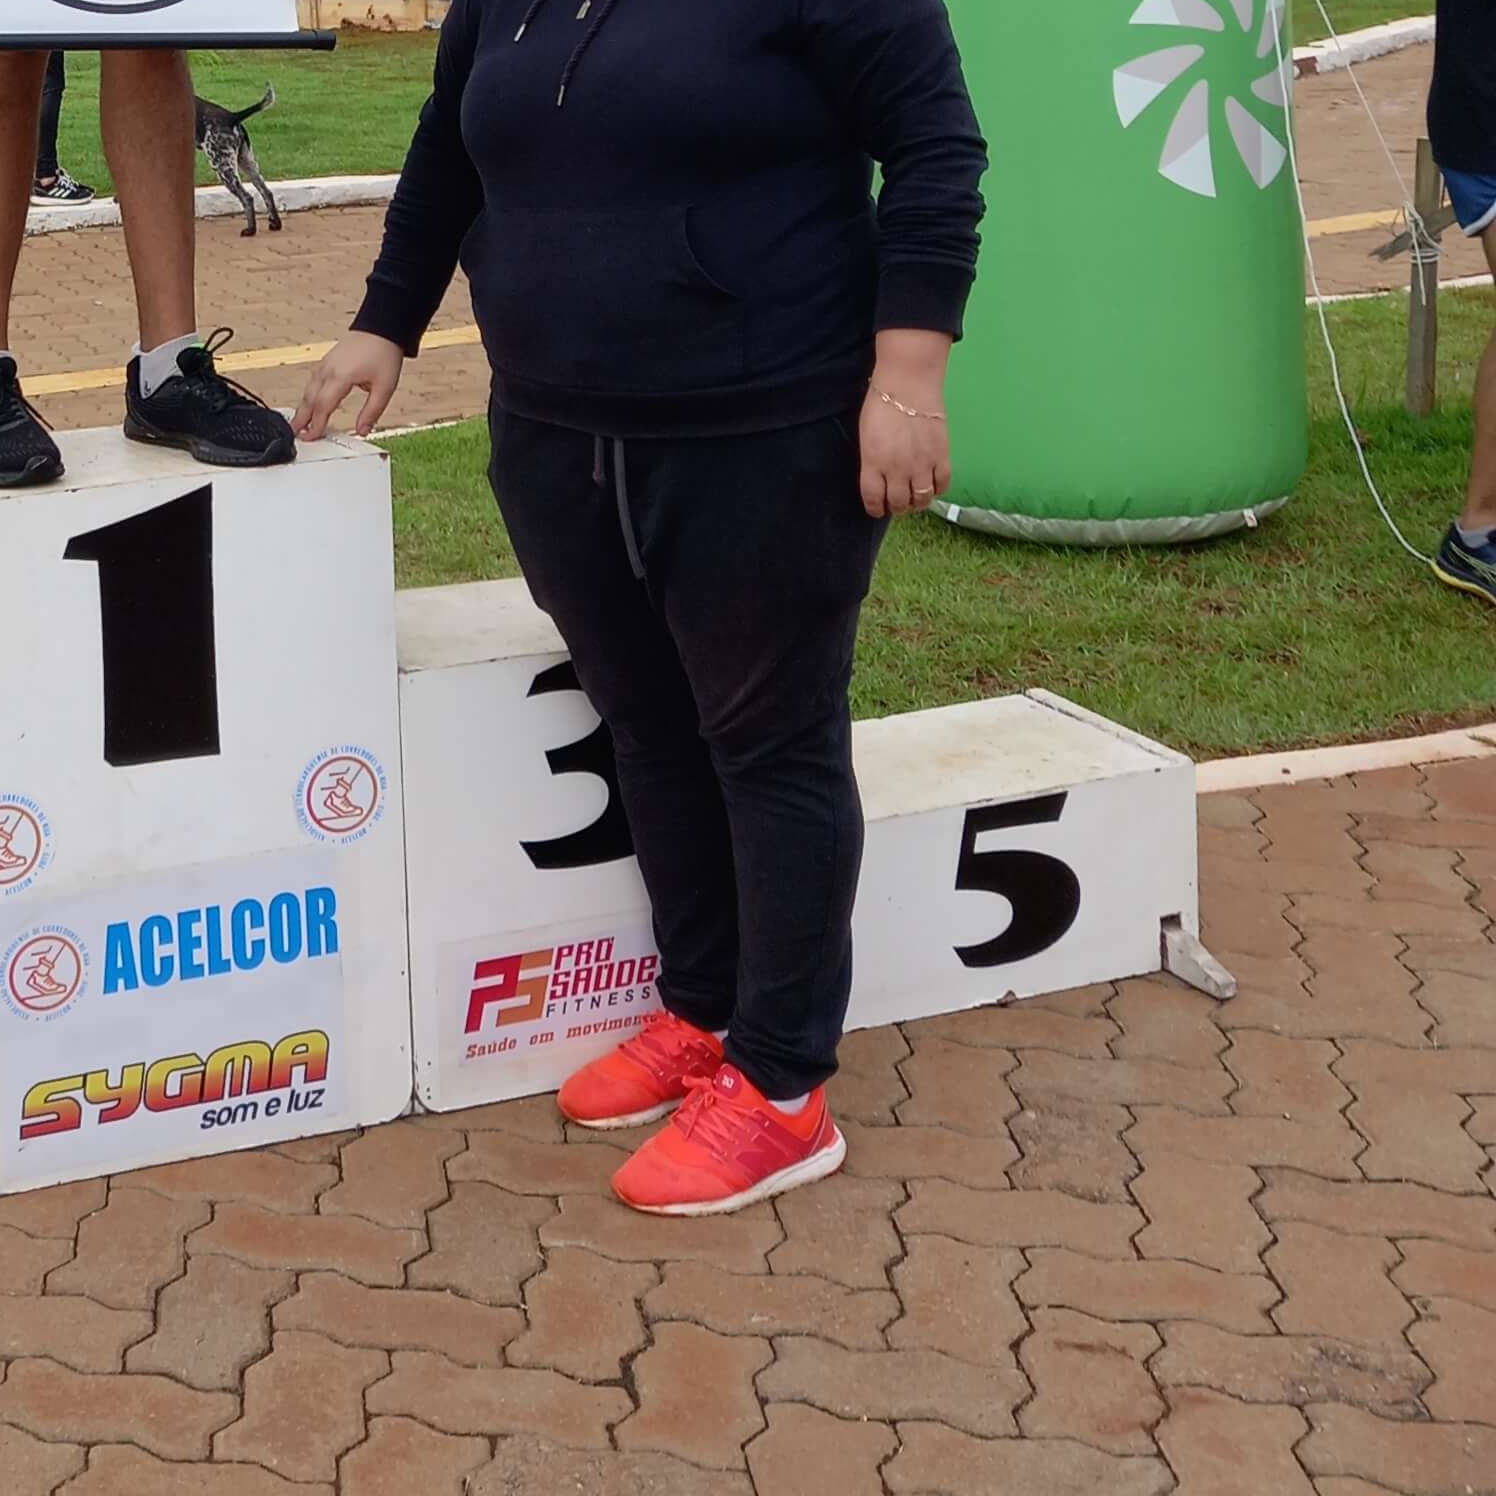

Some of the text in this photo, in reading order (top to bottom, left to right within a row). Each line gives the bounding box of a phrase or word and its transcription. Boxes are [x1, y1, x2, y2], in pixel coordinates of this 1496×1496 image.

[62, 482, 221, 769] 1
[519, 660, 639, 870] 3
[952, 791, 1081, 968] 5
[103, 886, 339, 995] ACELCOR
[529, 1031, 554, 1046] em
[545, 986, 651, 1018] FITNESS
[19, 1029, 330, 1140] SYGMA
[200, 1085, 326, 1129] som e luz
